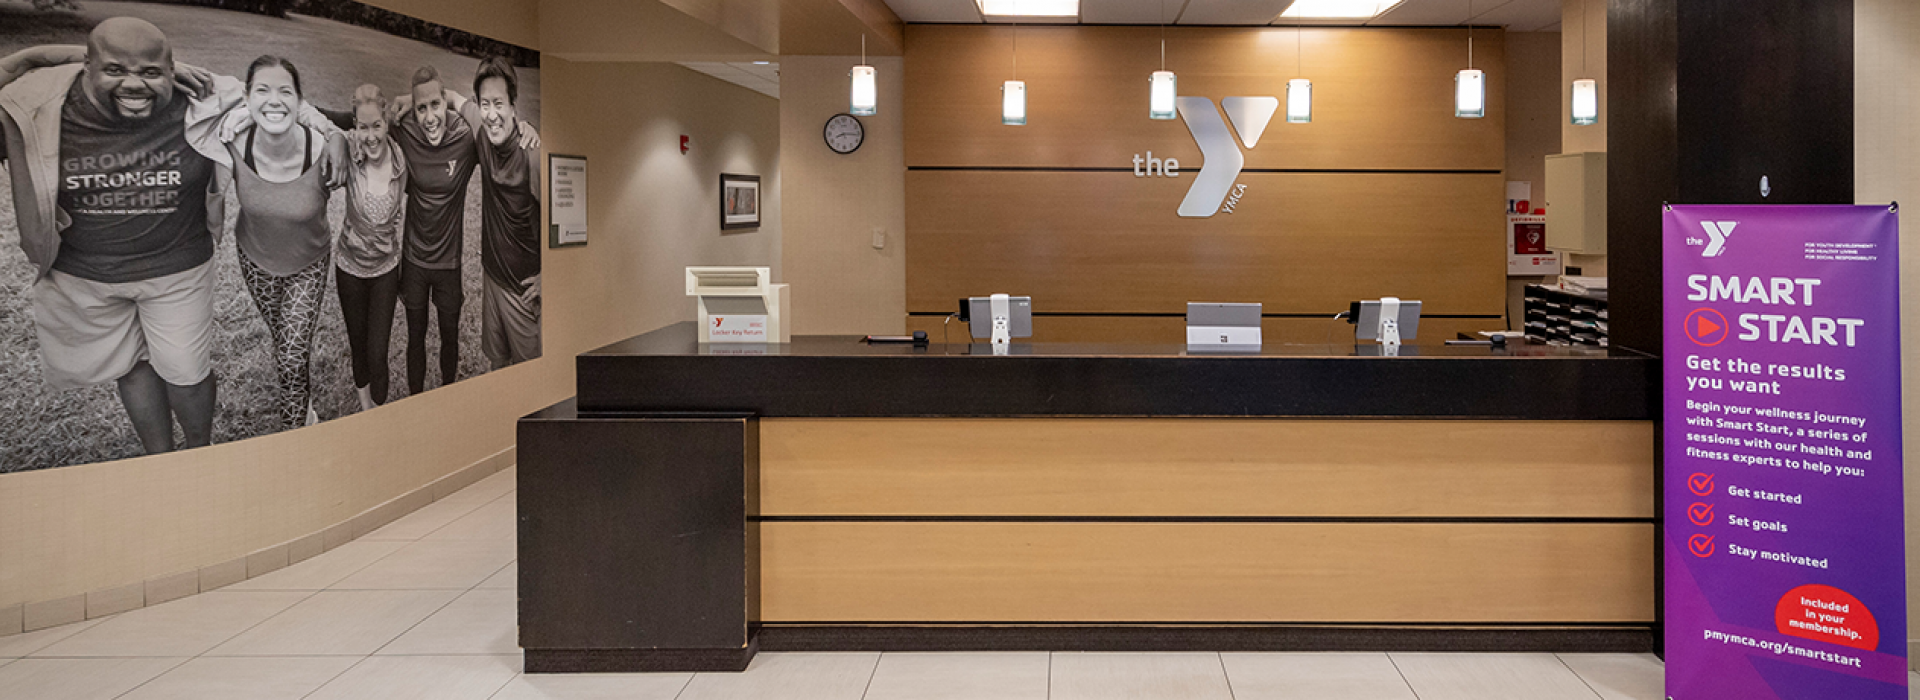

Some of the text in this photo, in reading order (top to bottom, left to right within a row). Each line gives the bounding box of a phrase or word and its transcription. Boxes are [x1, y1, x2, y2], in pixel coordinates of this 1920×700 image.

[64, 151, 181, 172] GROWING
[1132, 151, 1180, 177] the
[66, 170, 182, 190] STRONGER
[1221, 183, 1248, 215] YMCA
[1686, 236, 1704, 246] the
[1687, 274, 1821, 306] SMART
[1738, 313, 1865, 347] START
[1686, 355, 1846, 381] Get the results
[1686, 376, 1782, 396] you want
[1686, 399, 1867, 429] Begin your wellness journey
[1686, 416, 1868, 443] with Smart Start, a series of
[1686, 432, 1873, 462] sessions with our health and
[1686, 446, 1866, 478] fitness experts to help you:
[1728, 485, 1803, 505] Get started
[1728, 514, 1789, 533] Set goals
[1728, 544, 1829, 569] Stay motivated
[1800, 596, 1850, 614] Included
[1805, 608, 1845, 625] in your
[1788, 618, 1863, 641] membership.
[1703, 628, 1862, 668] pmymca.org/smartstart
